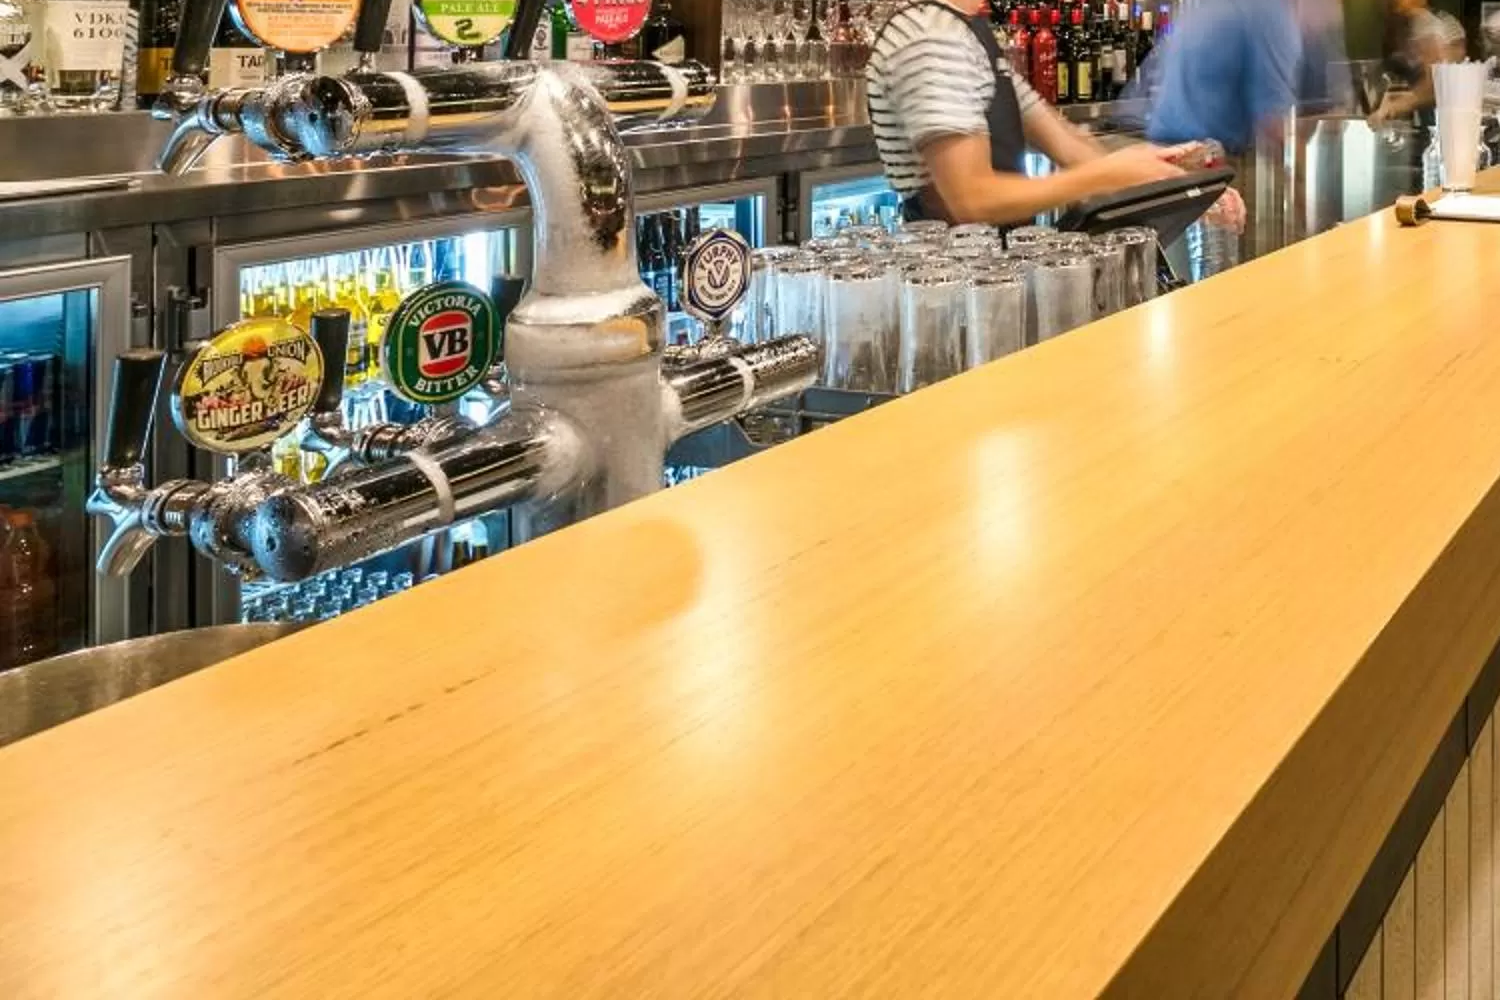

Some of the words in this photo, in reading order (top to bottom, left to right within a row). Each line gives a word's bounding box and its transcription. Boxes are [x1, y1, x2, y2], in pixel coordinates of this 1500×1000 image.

[441, 2, 473, 13] PALE
[409, 295, 482, 328] VICTORIA
[423, 327, 469, 361] VB
[414, 364, 479, 393] BITTER
[197, 401, 263, 430] GINGER
